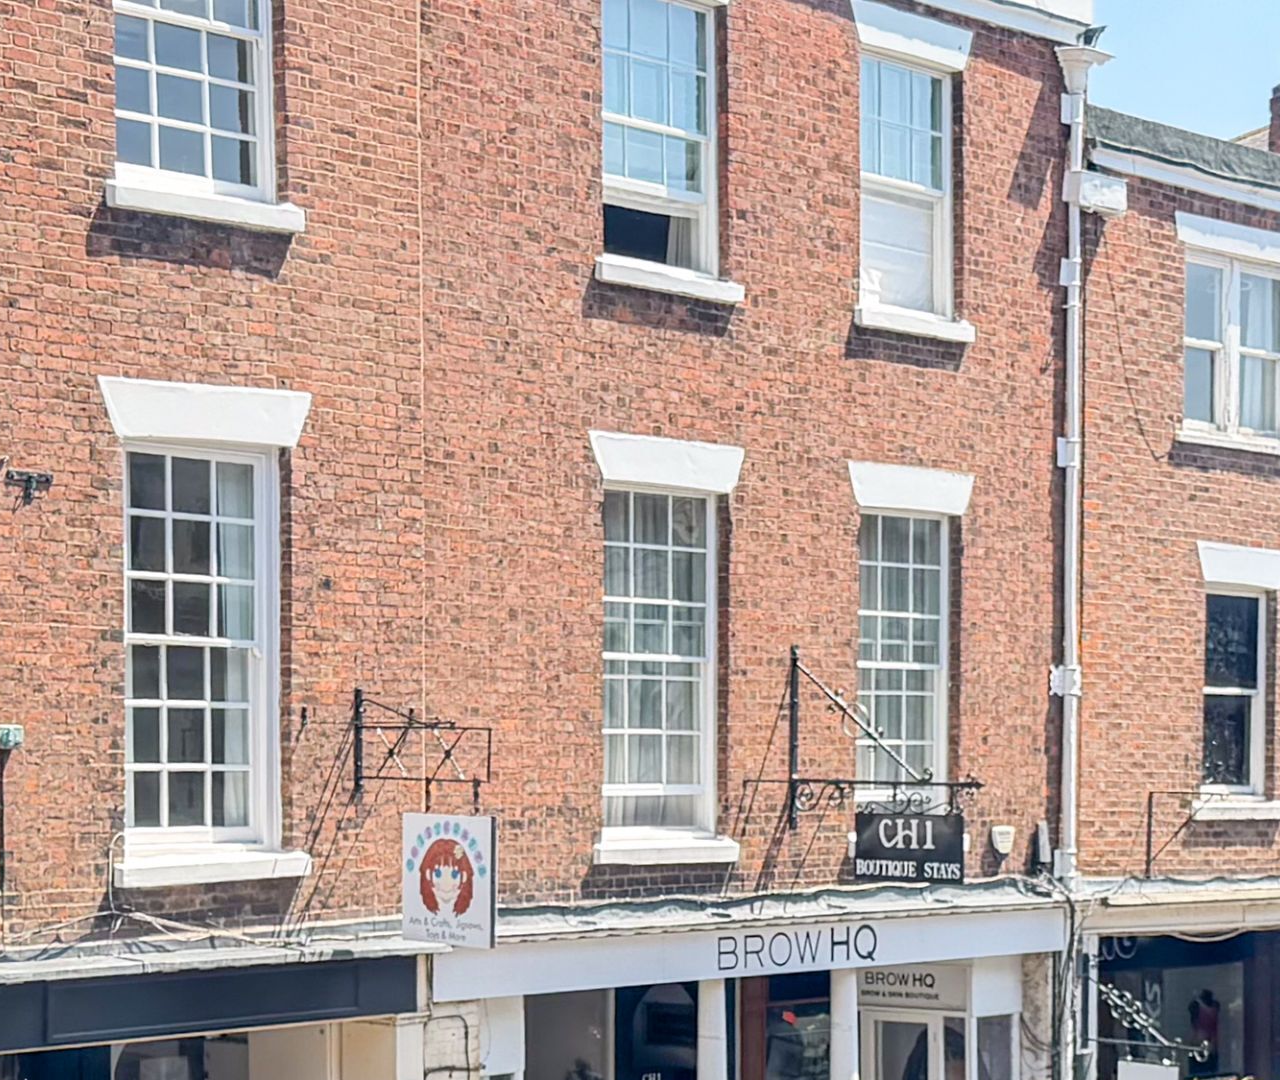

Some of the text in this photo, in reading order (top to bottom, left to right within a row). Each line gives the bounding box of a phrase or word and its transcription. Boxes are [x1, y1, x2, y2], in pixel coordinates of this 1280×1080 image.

[879, 819, 935, 849] CH1
[856, 858, 961, 879] BOUTIQUE STAYS
[718, 924, 878, 971] BROW HQ
[864, 971, 936, 989] BROW HQ
